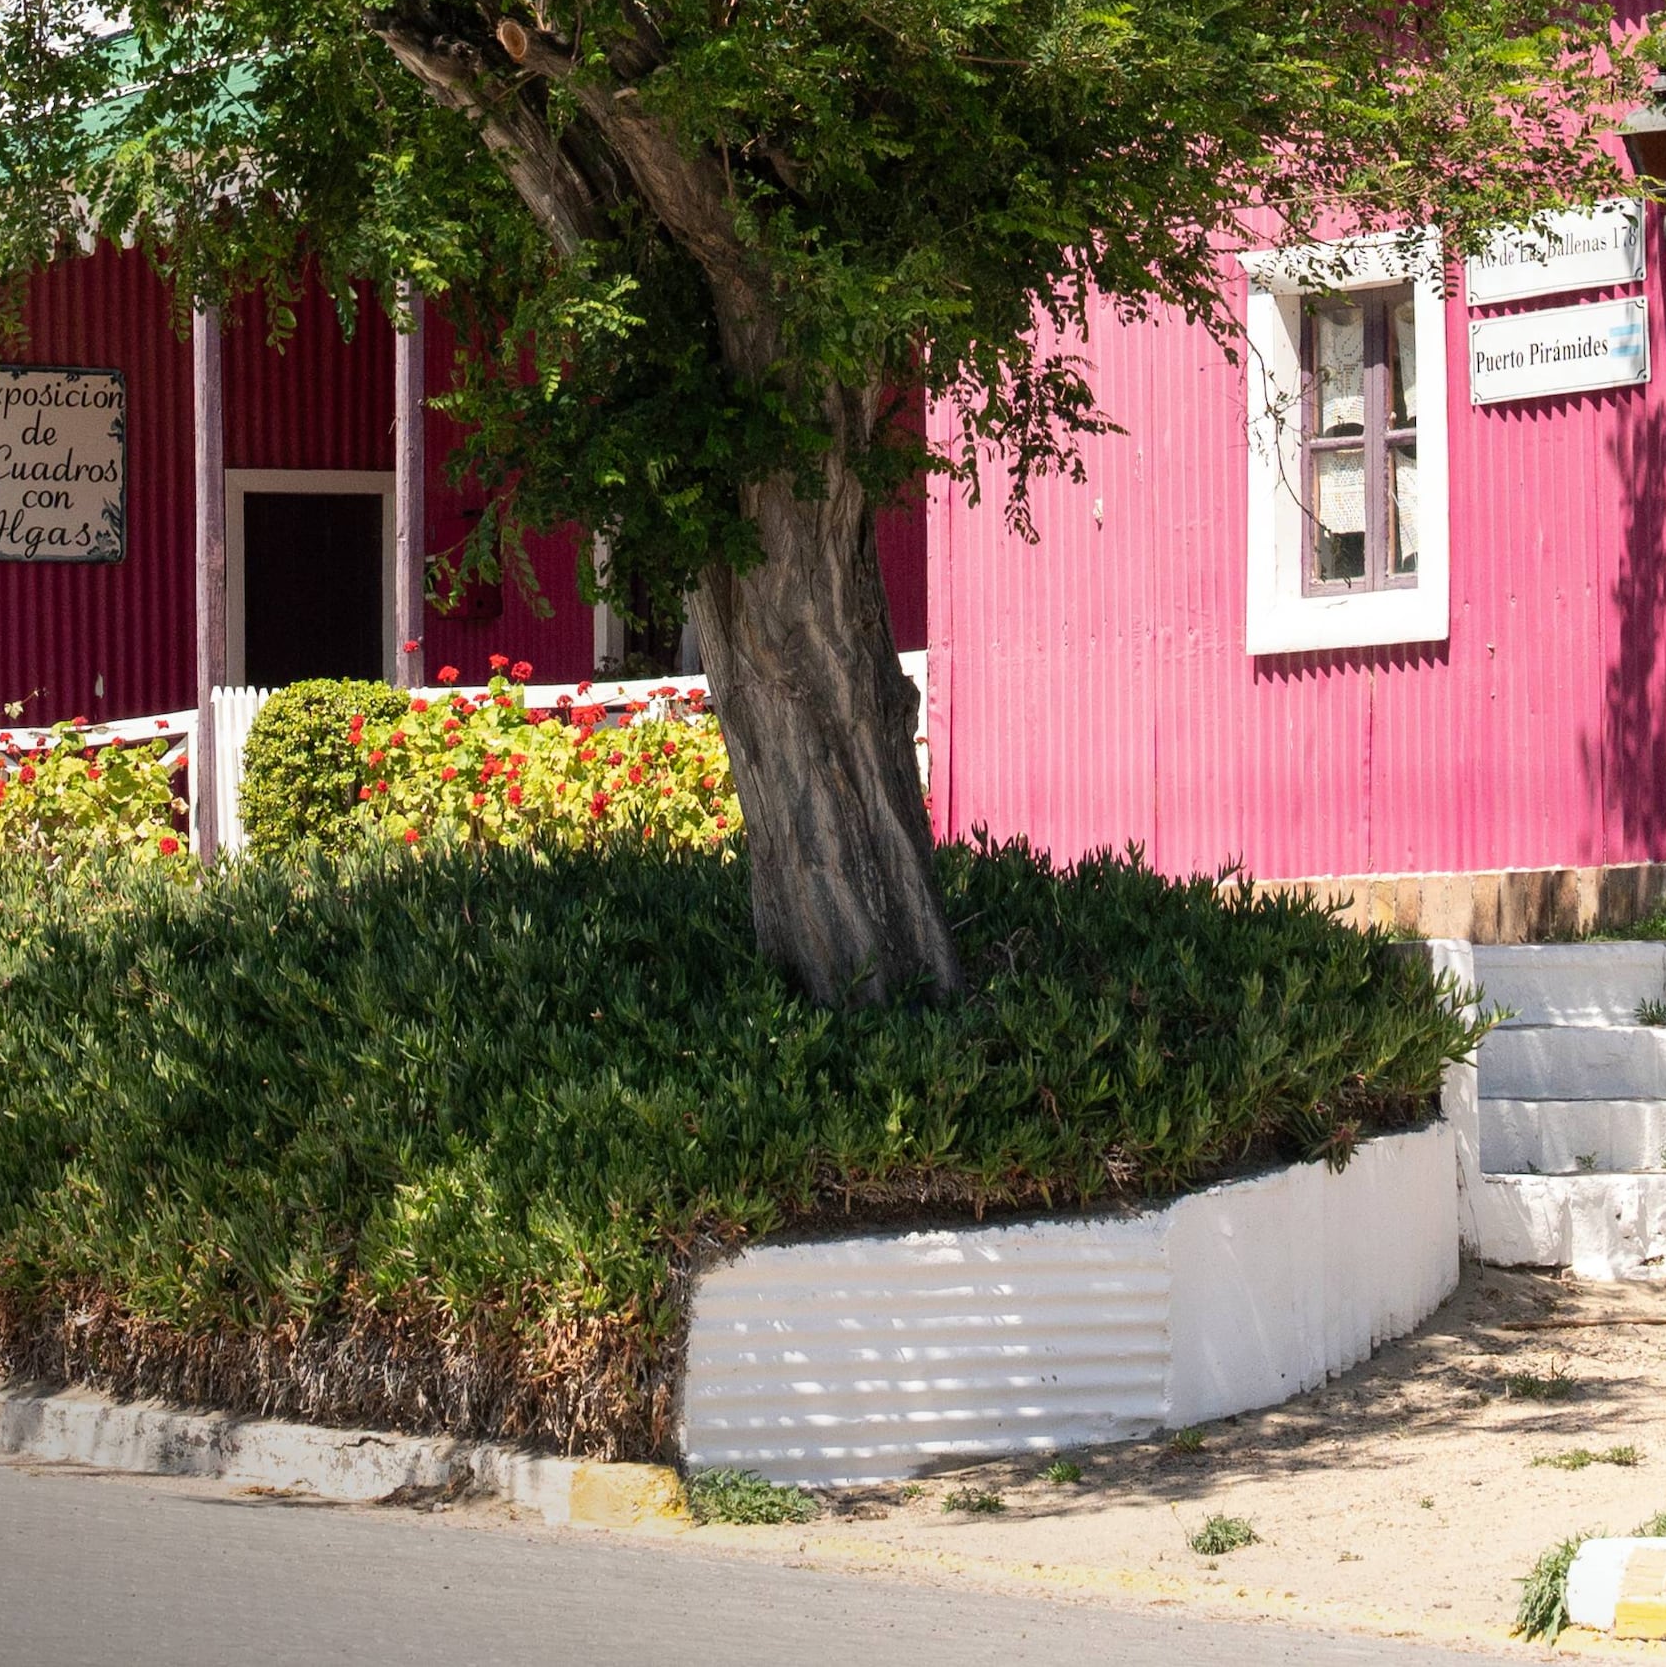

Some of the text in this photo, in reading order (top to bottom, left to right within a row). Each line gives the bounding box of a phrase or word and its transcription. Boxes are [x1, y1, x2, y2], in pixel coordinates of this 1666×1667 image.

[1499, 244, 1515, 266] de
[1546, 232, 1607, 259] Ballenas
[1475, 335, 1609, 374] Puerto Pirámides
[21, 410, 58, 445] de
[21, 489, 75, 510] con
